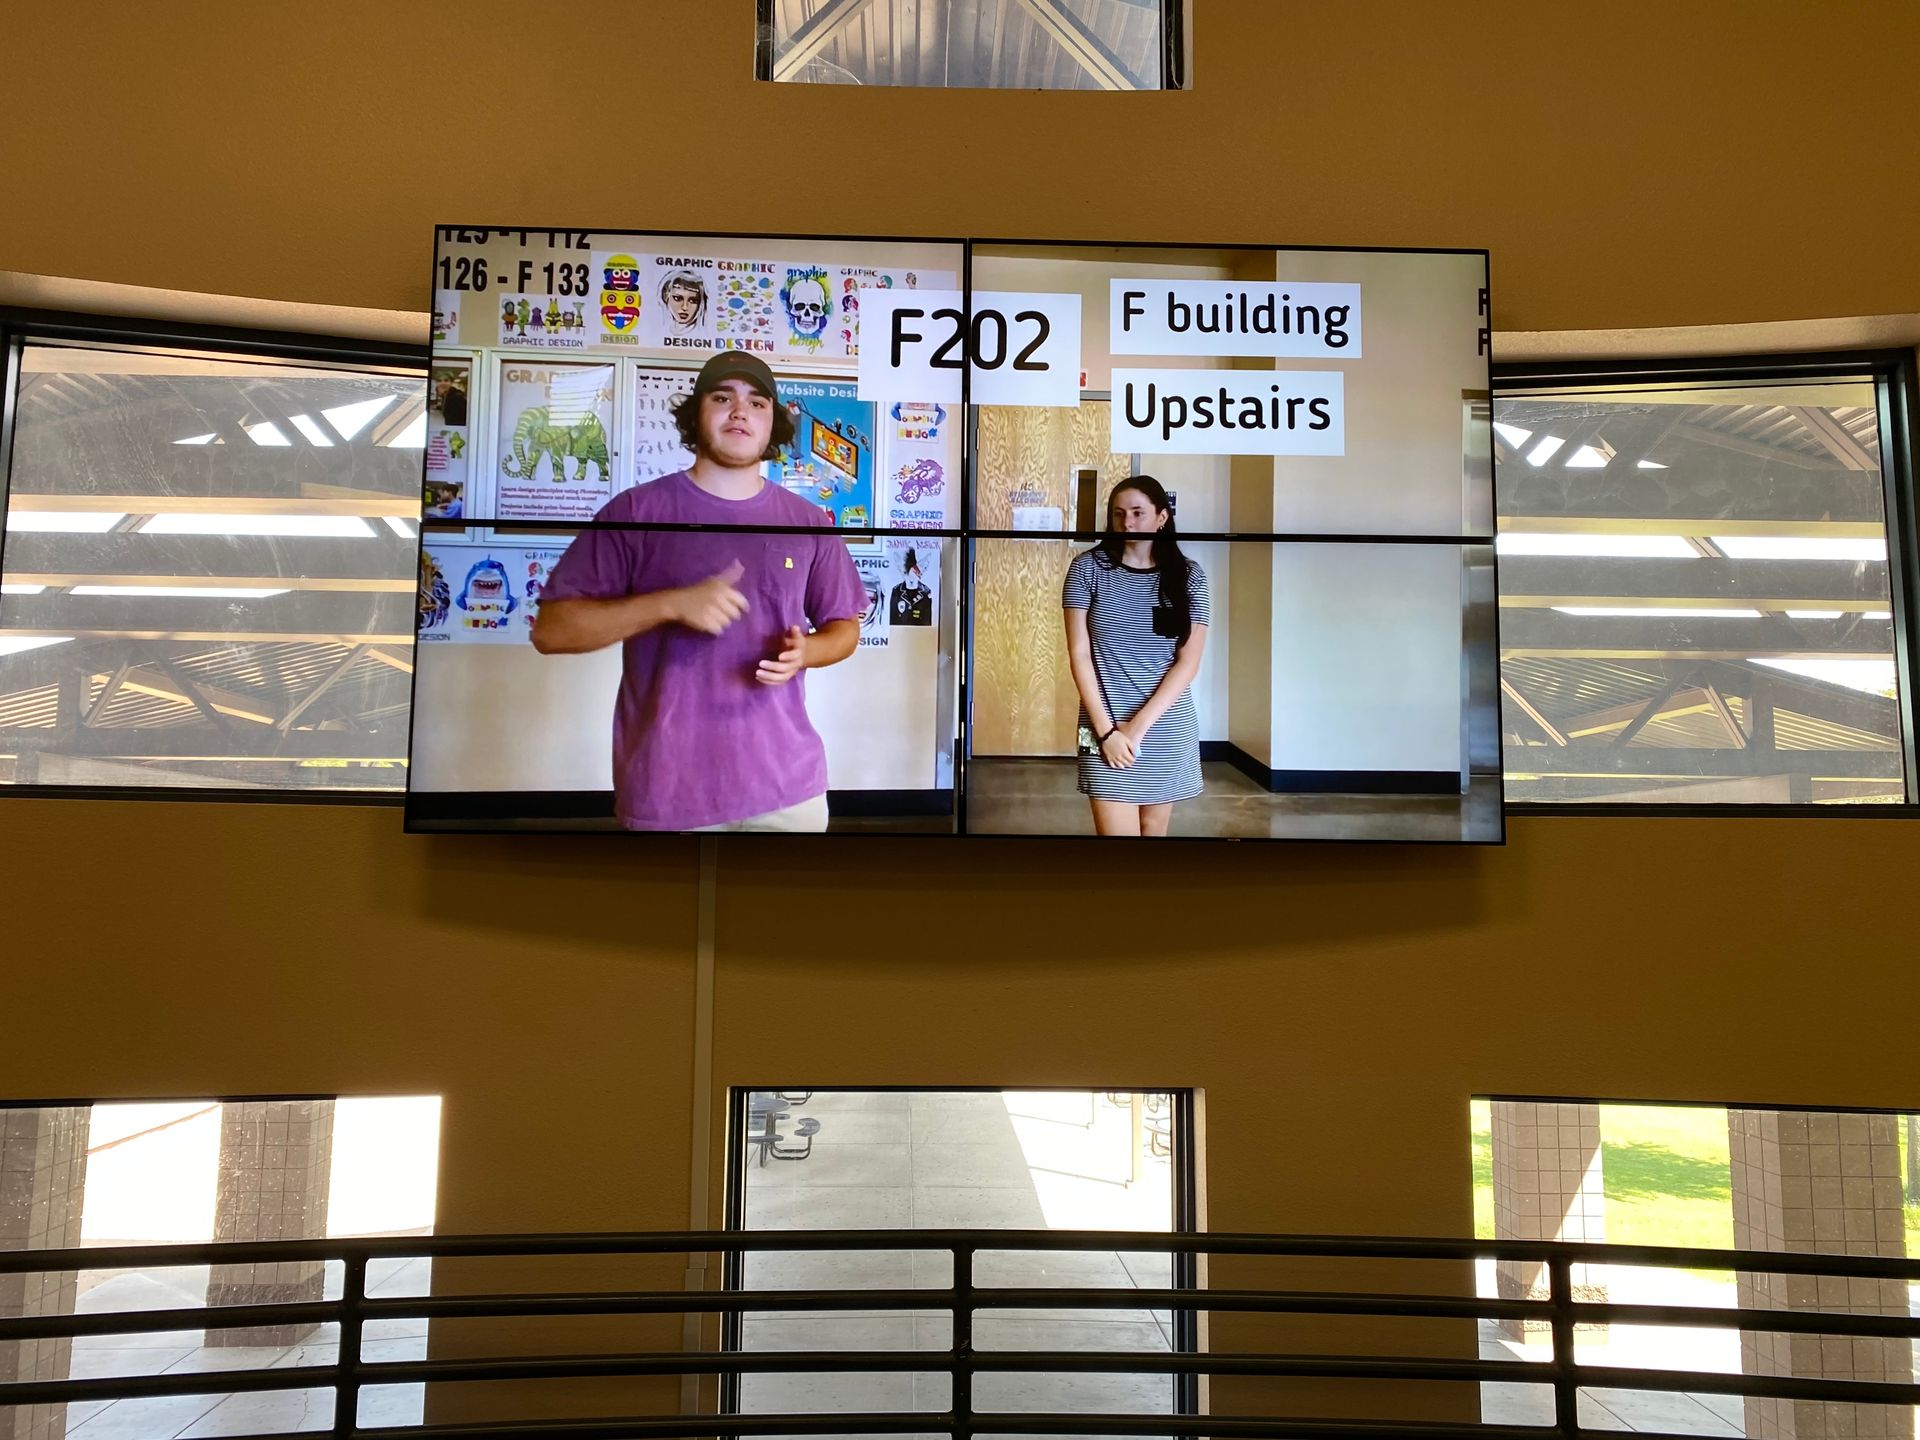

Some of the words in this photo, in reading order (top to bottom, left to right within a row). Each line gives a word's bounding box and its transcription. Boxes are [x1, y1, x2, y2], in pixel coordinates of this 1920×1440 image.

[655, 256, 713, 269] GRAPHIC
[717, 260, 776, 274] GRAPHIC
[439, 255, 488, 292] 126
[518, 260, 533, 293] F
[543, 261, 590, 297] 133
[1123, 291, 1146, 332] F
[1167, 291, 1351, 349] building
[502, 336, 545, 347] GRAPHIC
[548, 337, 584, 348] DESIGN
[663, 336, 712, 349] DESIGN
[715, 337, 774, 352] DESIGN
[890, 308, 1051, 371] F202
[775, 383, 825, 398] Website
[829, 386, 858, 399] Desi
[1125, 382, 1332, 441] Upstairs
